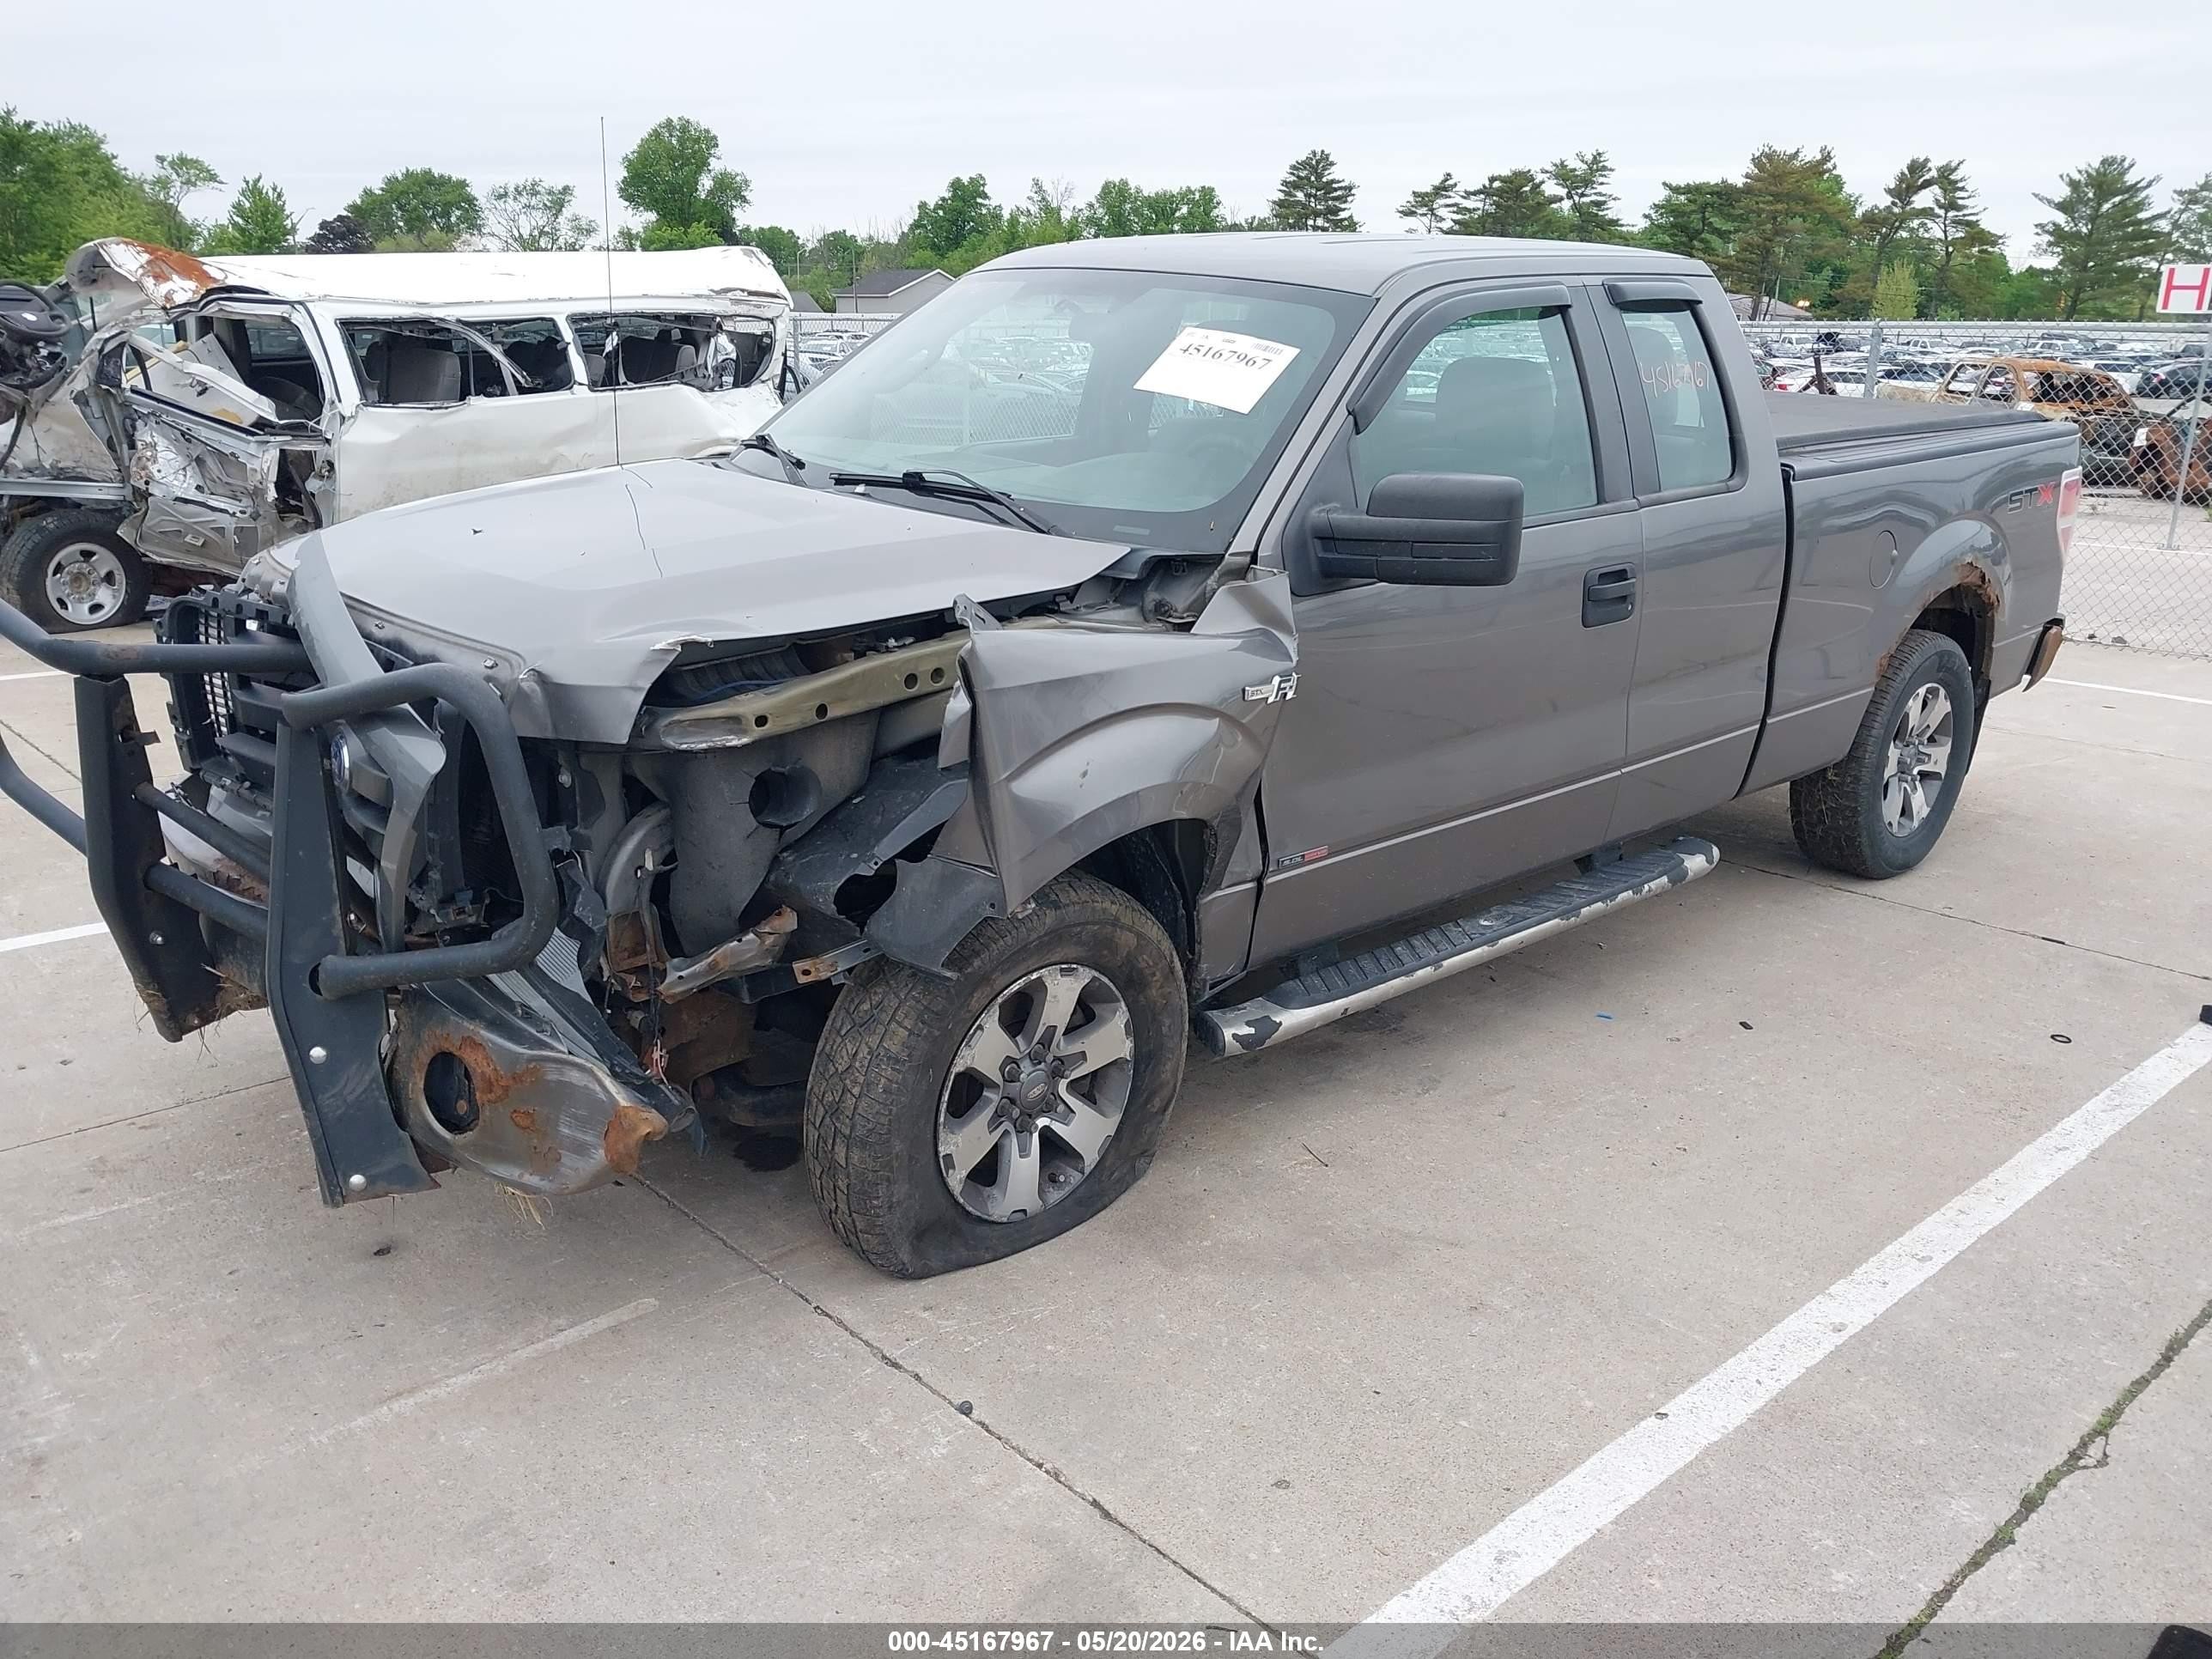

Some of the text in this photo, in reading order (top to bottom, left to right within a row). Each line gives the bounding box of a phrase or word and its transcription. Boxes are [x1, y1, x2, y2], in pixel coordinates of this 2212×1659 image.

[2161, 267, 2210, 310] H
[1180, 343, 1273, 370] 45167967
[2007, 481, 2056, 514] STX
